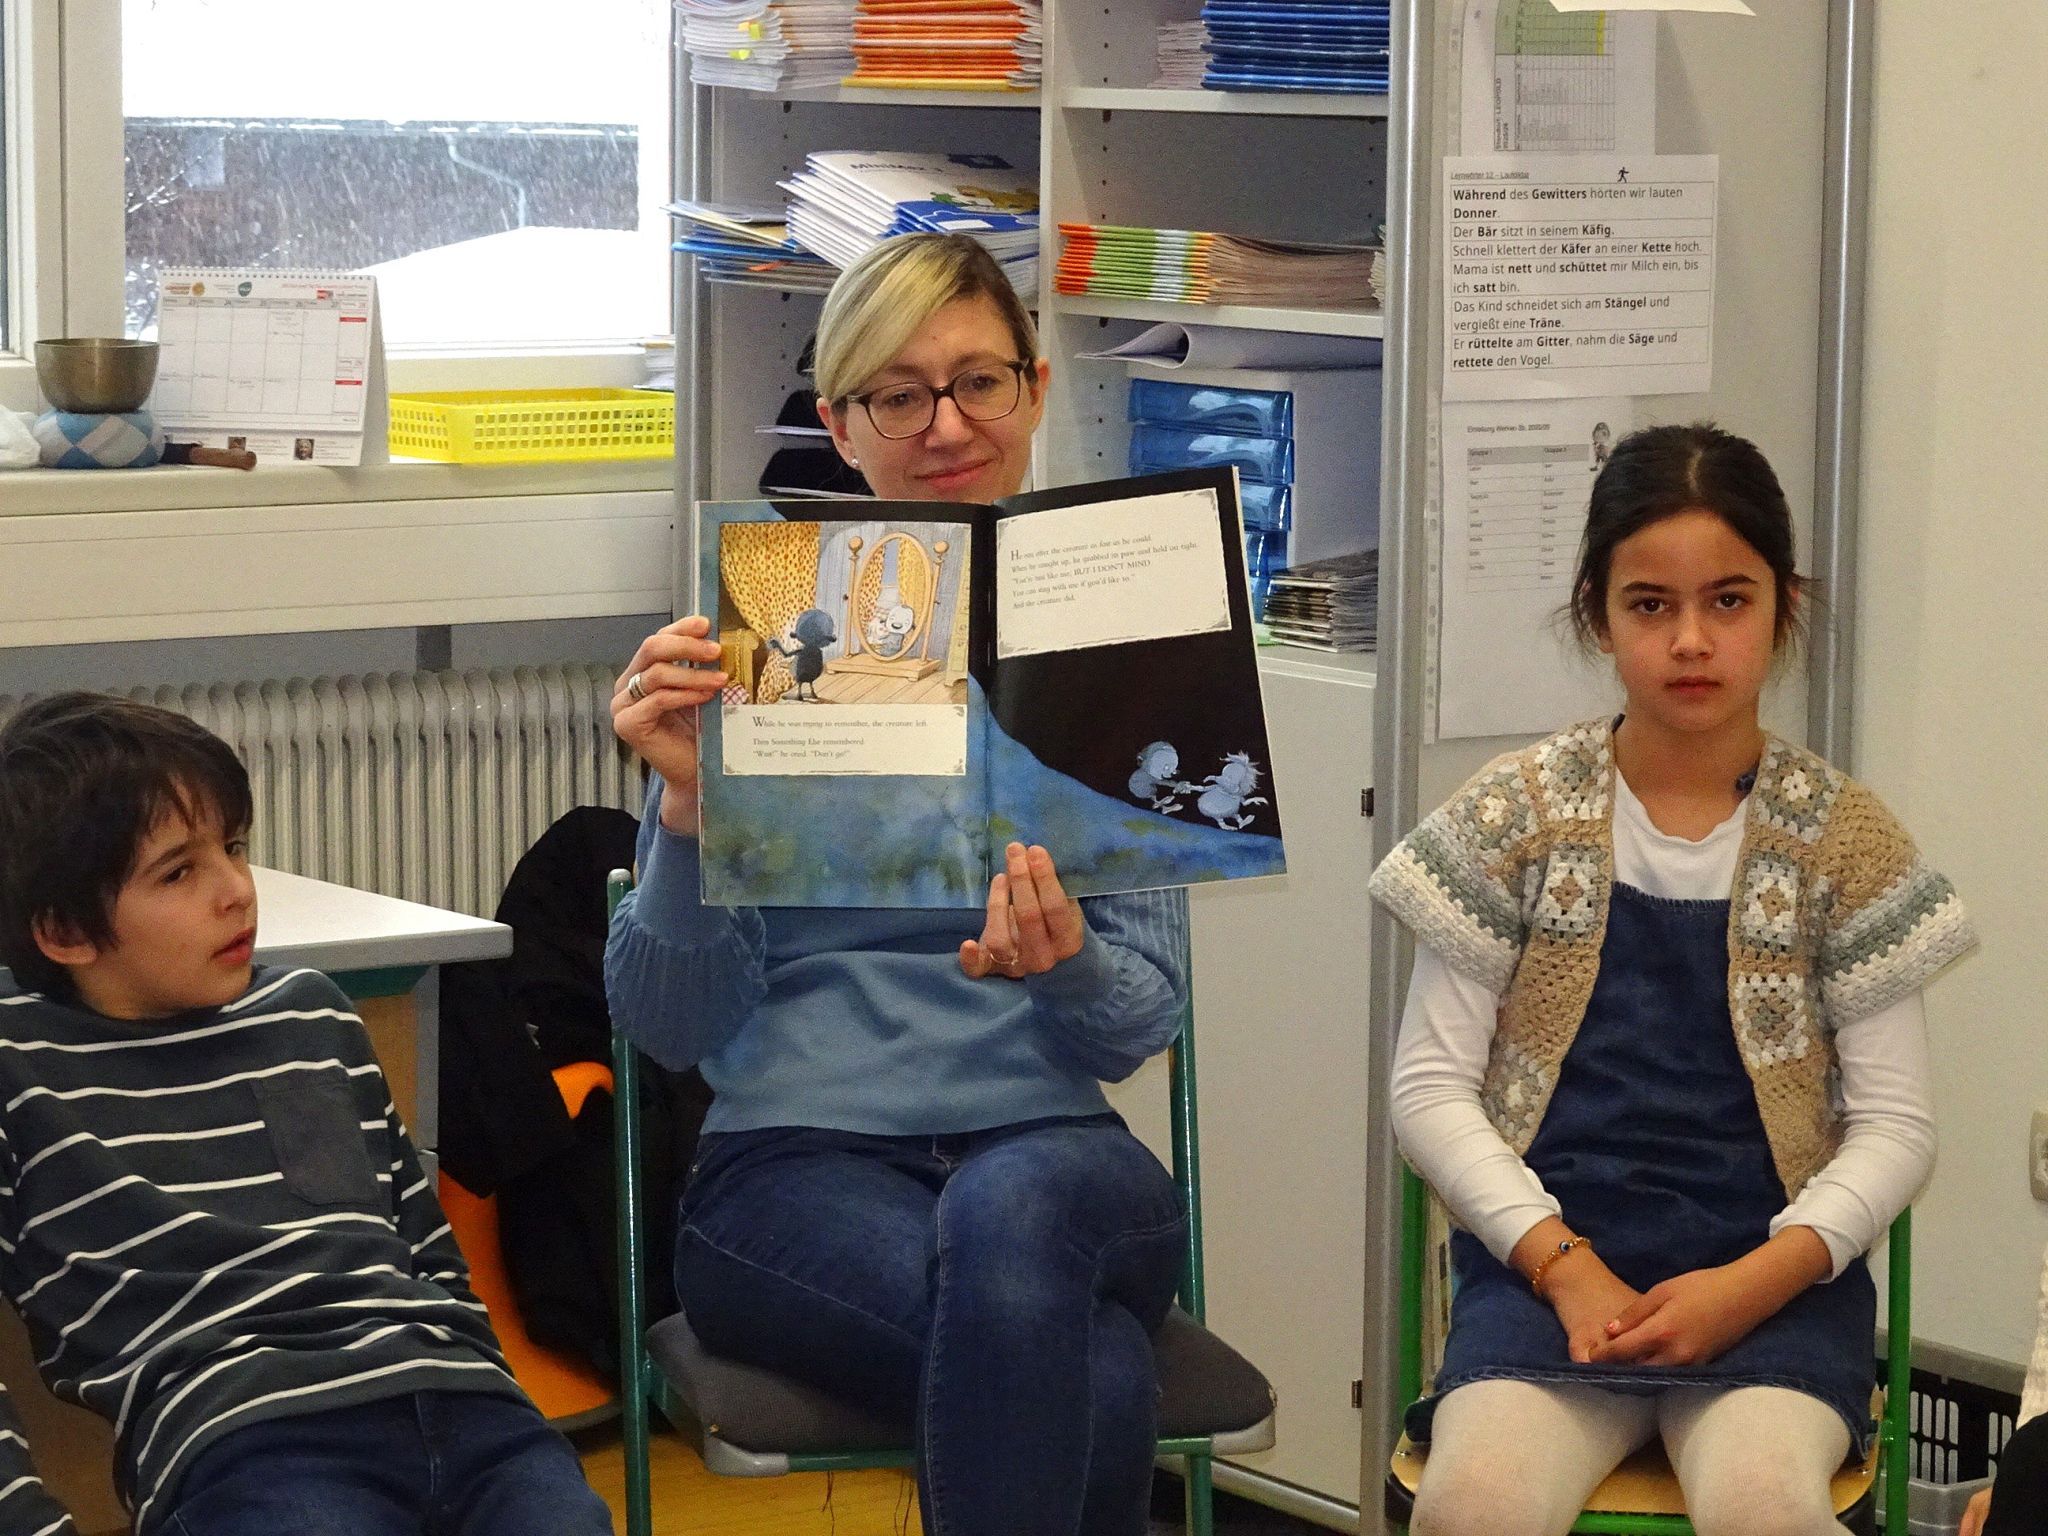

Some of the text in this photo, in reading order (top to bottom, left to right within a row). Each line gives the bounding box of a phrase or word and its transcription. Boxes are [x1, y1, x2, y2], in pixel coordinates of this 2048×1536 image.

[1453, 187, 1683, 200] Während des Gewitters hörten wir lauten
[1454, 225, 1614, 238] Der Bär sitzt in seinem Käfig.
[1453, 241, 1702, 256] Schnell klettert der Käfer an einer Kette hoch.
[1454, 264, 1488, 274] Mama
[1492, 263, 1504, 274] ist
[1508, 263, 1532, 273] nett
[1535, 262, 1556, 273] und
[1559, 261, 1607, 273] schüttet
[1610, 262, 1628, 272] mir
[1632, 260, 1659, 271] Milch
[1684, 259, 1698, 270] bis
[1454, 281, 1520, 293] ich satt bin.
[1454, 297, 1670, 312] Das Kind schneidet sich am Stängel und
[1454, 317, 1564, 333] vergießt eine Träne.
[1454, 339, 1464, 350] Er
[1468, 337, 1513, 348] rüttelte
[1517, 339, 1533, 347] am
[1576, 335, 1606, 346] nahm
[1609, 334, 1625, 345] die
[1629, 333, 1654, 346] Säge
[1658, 332, 1677, 343] und
[1454, 355, 1553, 368] rettete den Vogel.
[1051, 547, 1061, 555] the
[1083, 553, 1110, 564] grabbed
[1120, 550, 1135, 560] paw
[1137, 548, 1151, 556] and
[1074, 567, 1090, 576] BUT
[1098, 562, 1124, 573] DON'T
[1052, 583, 1067, 591] with
[872, 720, 883, 728] the
[771, 738, 806, 747] Something
[780, 750, 788, 758] he
